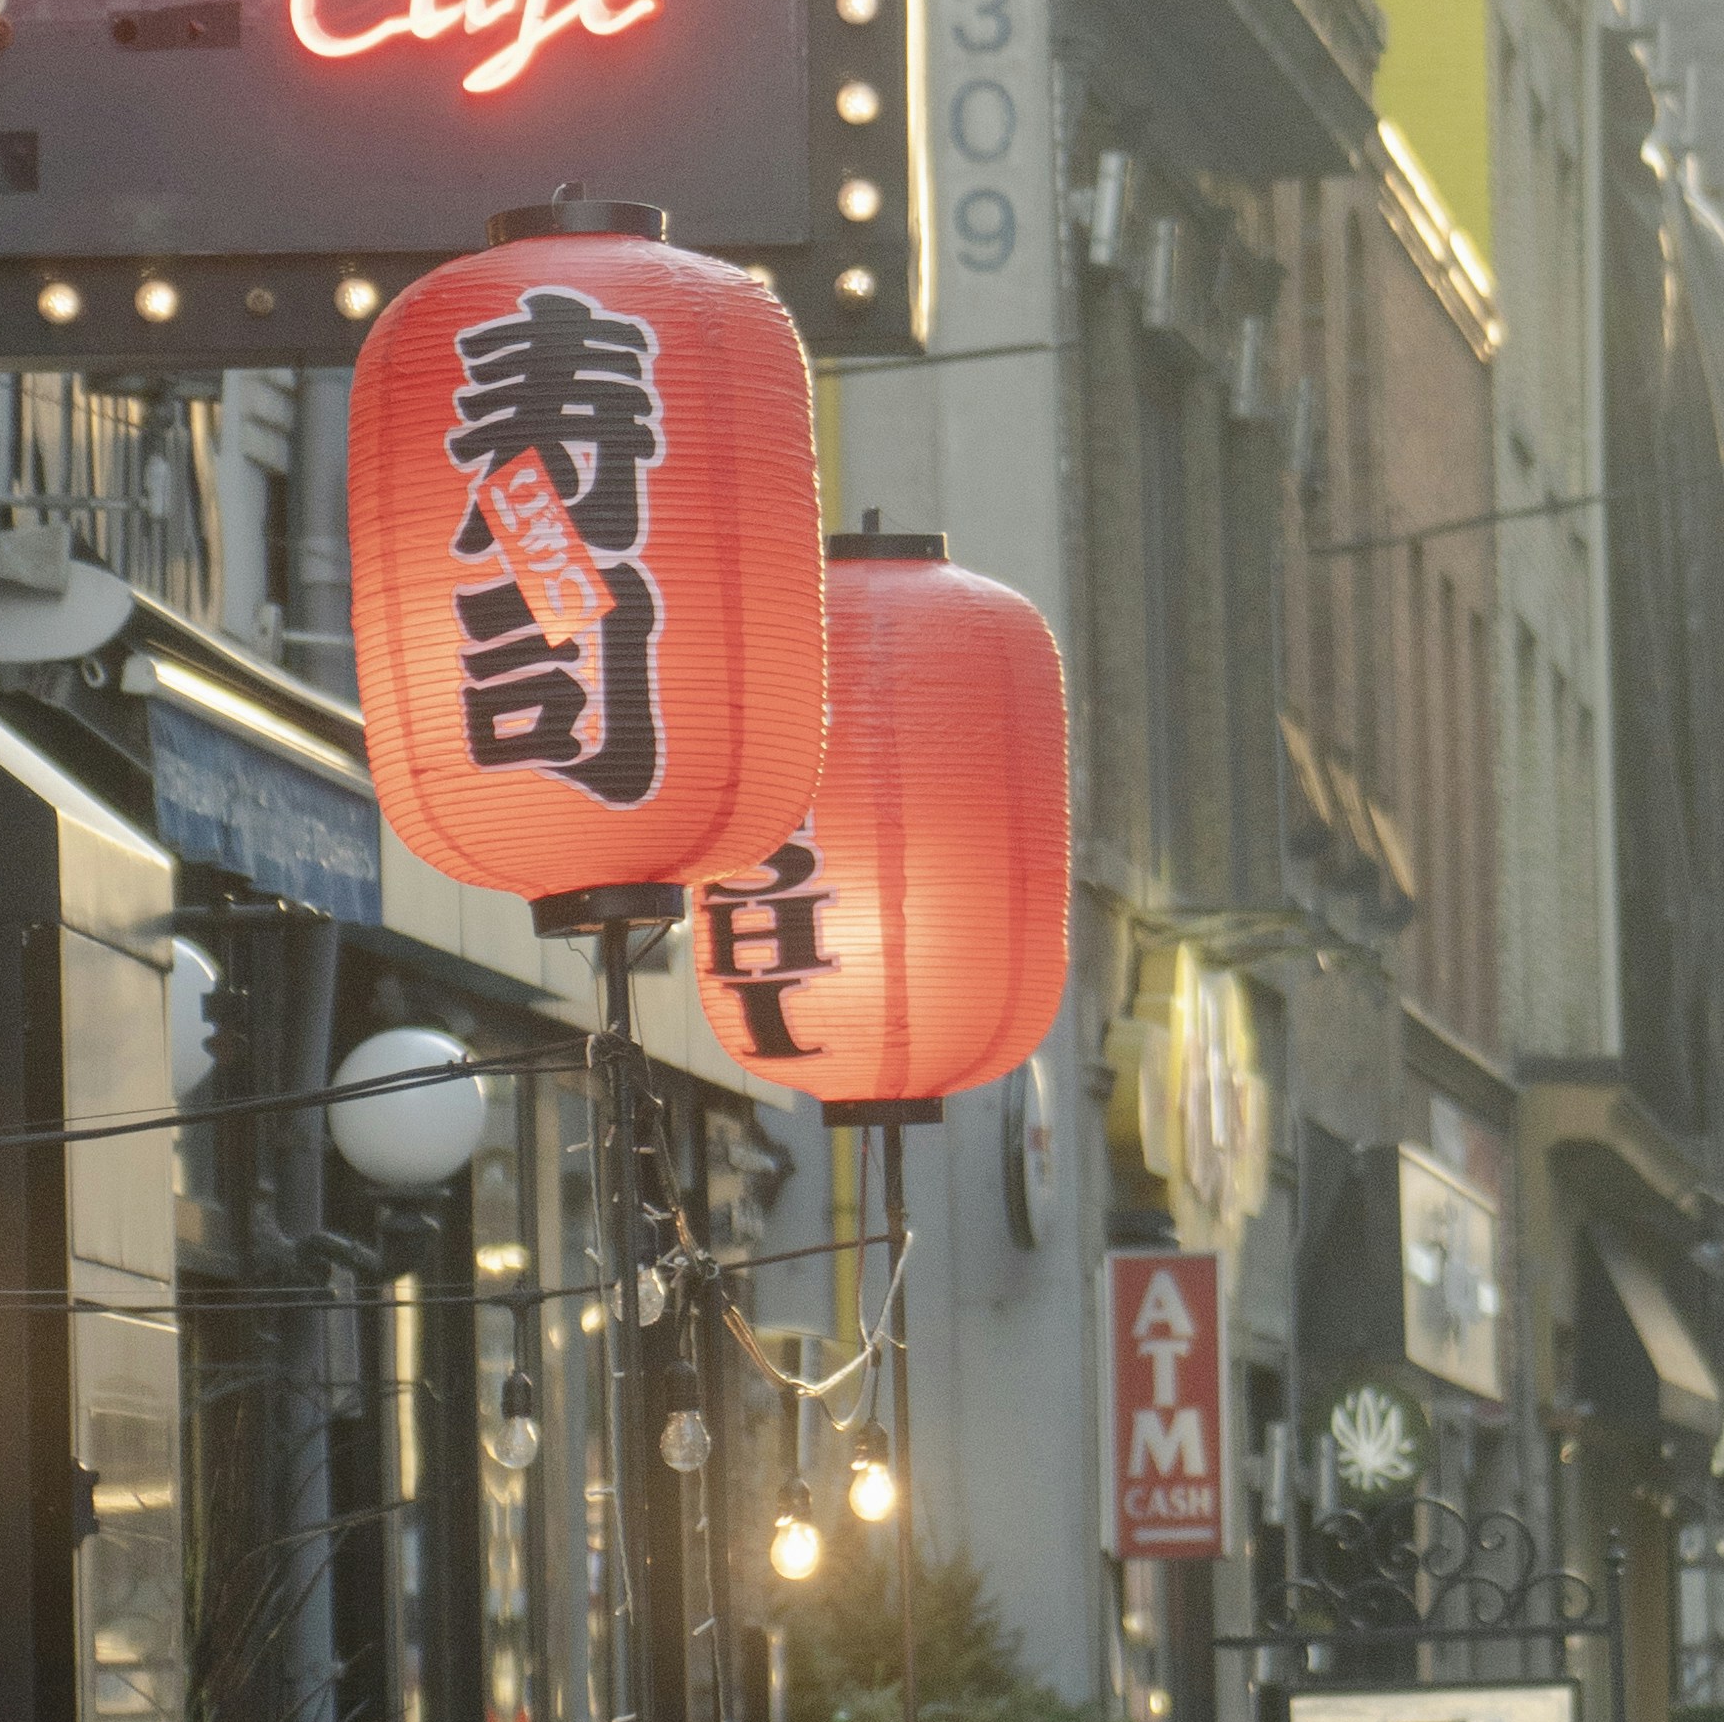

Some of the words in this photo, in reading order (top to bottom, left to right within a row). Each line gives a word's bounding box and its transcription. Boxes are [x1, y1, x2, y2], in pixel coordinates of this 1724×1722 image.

[444, 287, 664, 811] 寿司
[700, 811, 838, 1059] SHI
[1129, 1269, 1208, 1477] ATM
[1125, 1486, 1213, 1519] CASH
